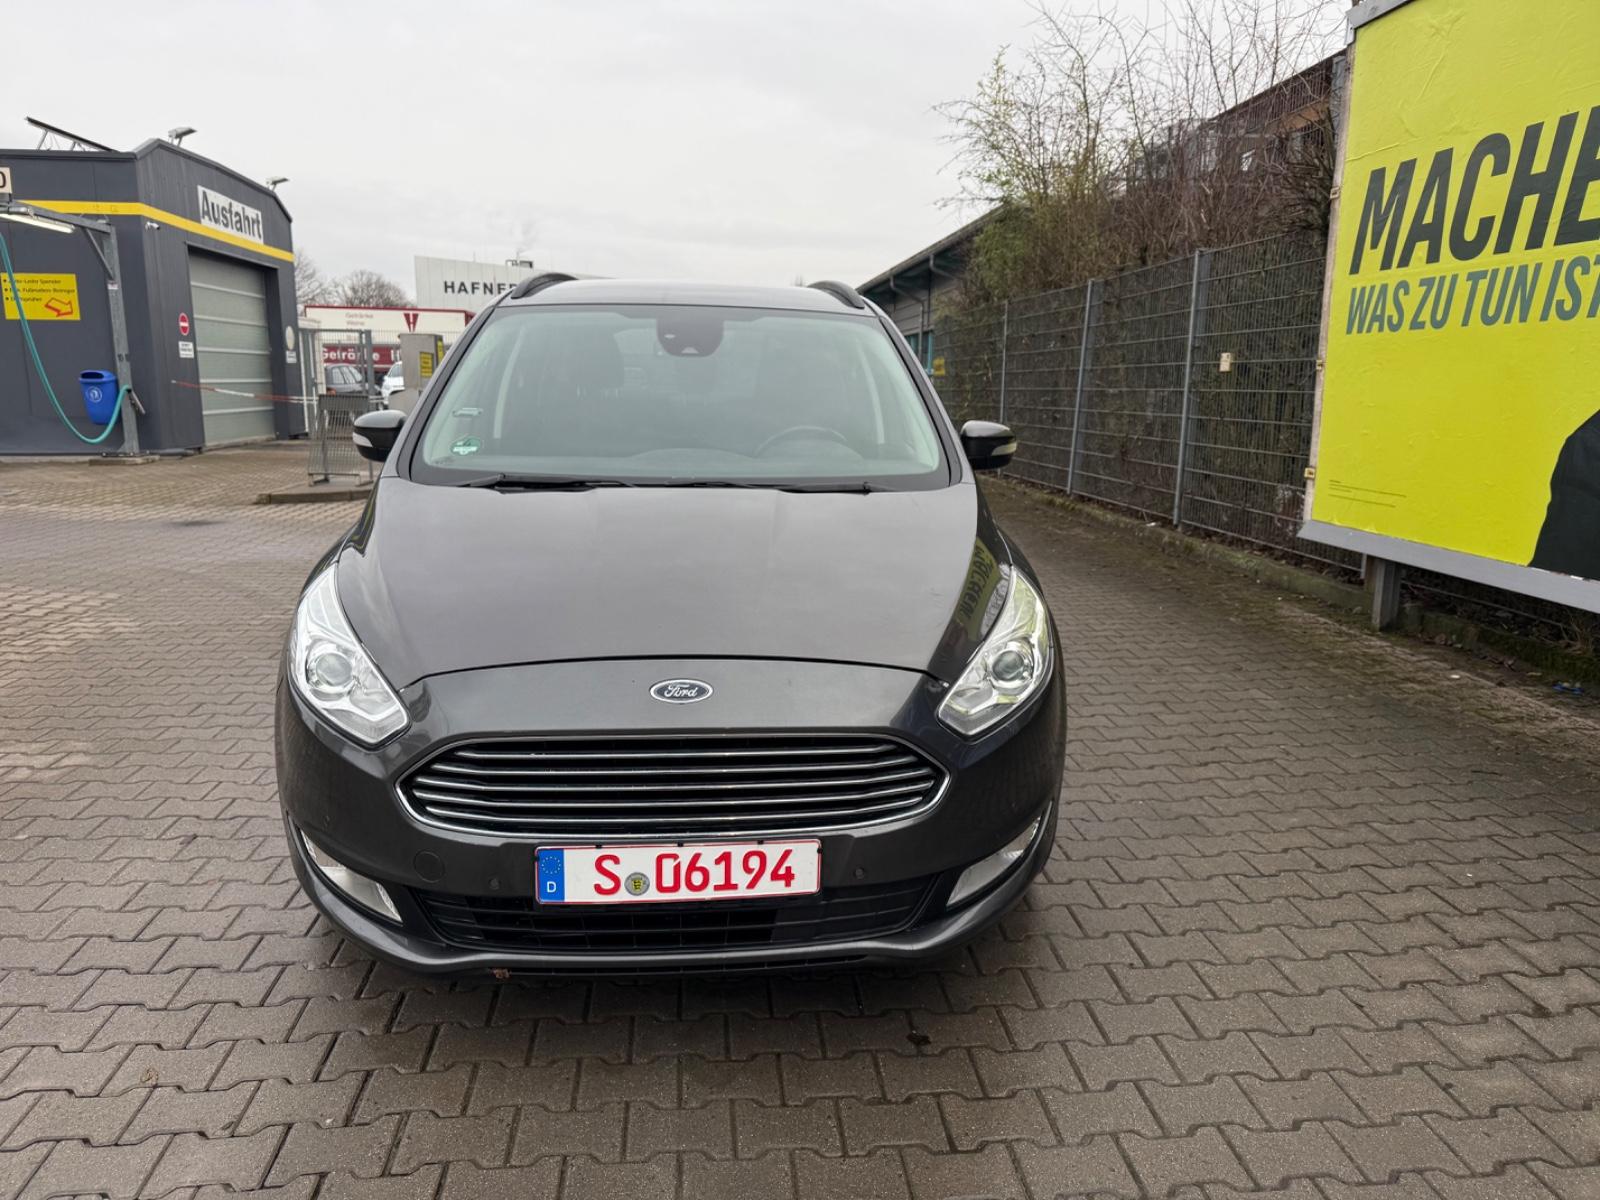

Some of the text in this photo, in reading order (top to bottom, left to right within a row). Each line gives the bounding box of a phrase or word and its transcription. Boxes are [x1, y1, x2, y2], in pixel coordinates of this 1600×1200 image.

[201, 190, 262, 240] Ausfahrt
[1348, 105, 1600, 276] MACHE
[1346, 279, 1411, 335] WAS
[1409, 273, 1459, 331] ZU
[1460, 262, 1544, 328] TUN
[546, 881, 557, 893] D
[593, 848, 796, 896] S 06194
